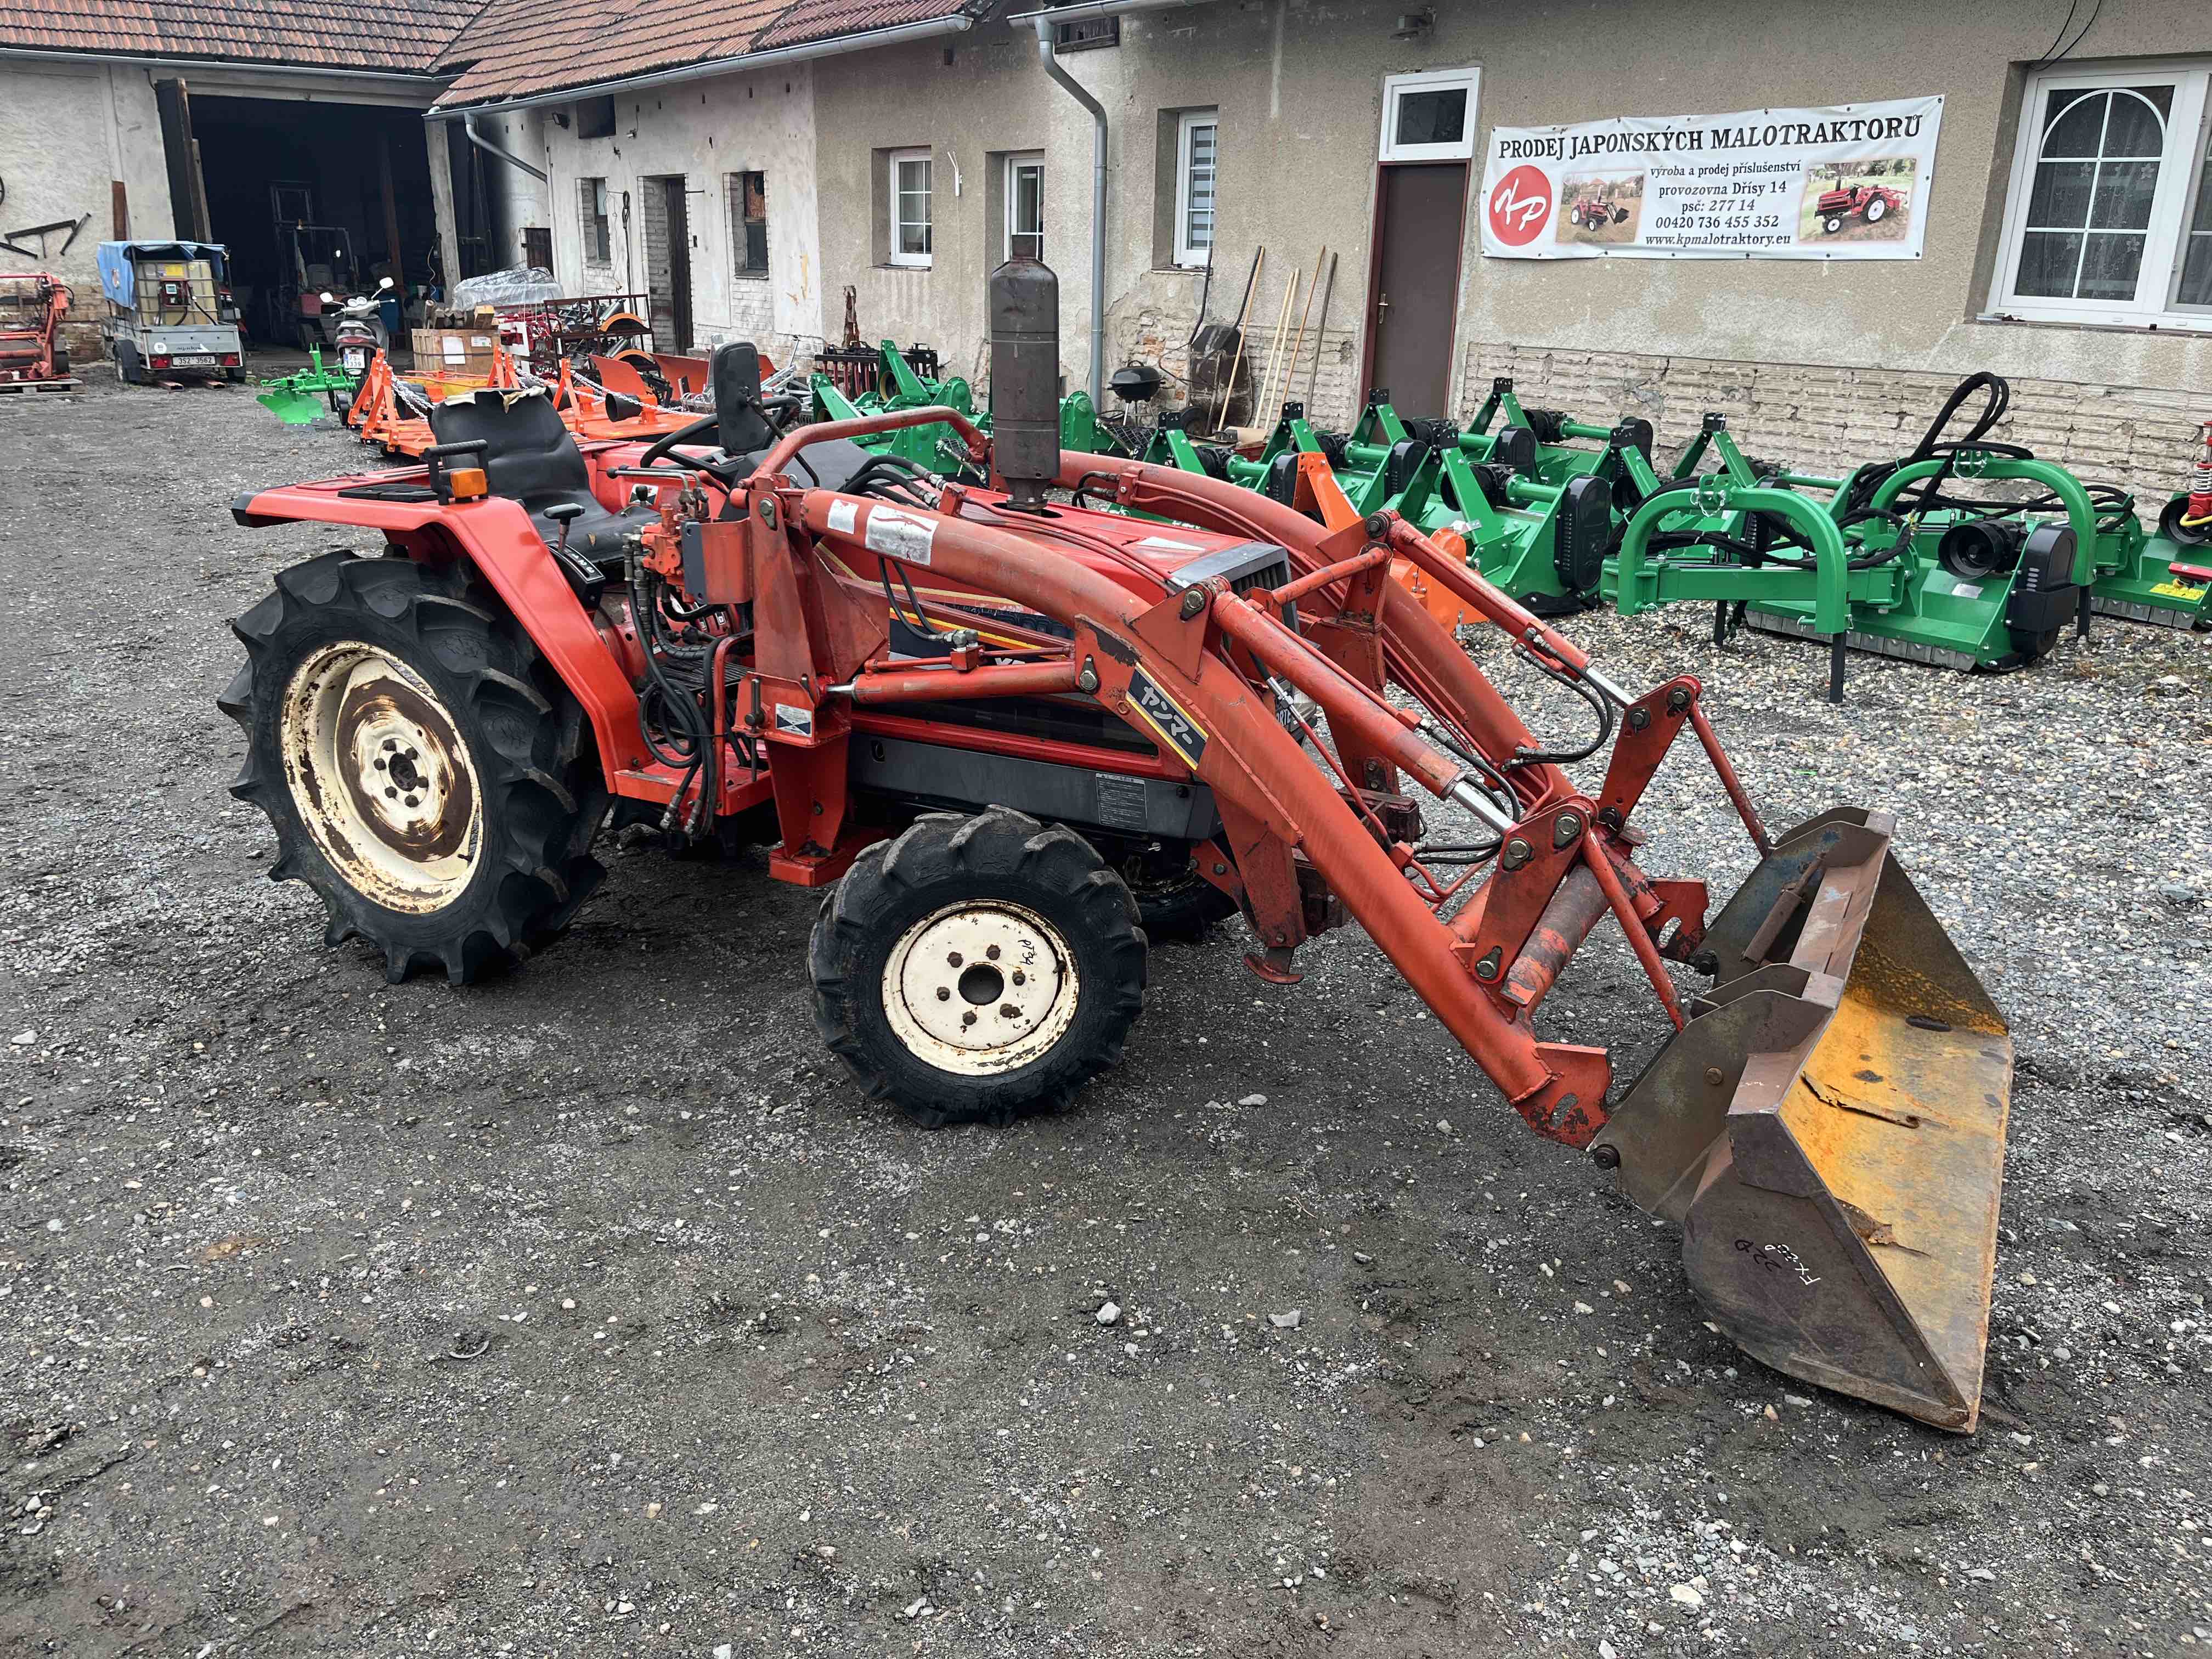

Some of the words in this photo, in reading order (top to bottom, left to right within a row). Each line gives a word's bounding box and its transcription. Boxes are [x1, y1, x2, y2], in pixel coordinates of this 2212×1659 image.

[1498, 137, 1565, 161] PRODEJ
[1569, 125, 1703, 160] JAPONSKÝCH
[1711, 115, 1922, 149] MALOTRAKTORŮ
[1650, 164, 1685, 178] výroba
[1698, 163, 1729, 178] prodej
[1732, 160, 1802, 176] příslušenství
[1659, 185, 1728, 198] provozovna
[1733, 182, 1765, 196] Dřísy
[1770, 180, 1787, 193] 14
[1681, 201, 1704, 215] psč:
[1709, 200, 1735, 211] 277
[1739, 199, 1755, 211] 14
[1656, 217, 1694, 229] 00420
[1699, 216, 1720, 228] 736
[1725, 216, 1750, 228] 455
[1753, 215, 1779, 228] 352
[1646, 233, 1791, 247] www.kpmalotraktory.eu
[1141, 686, 1193, 744] ヤンマー
